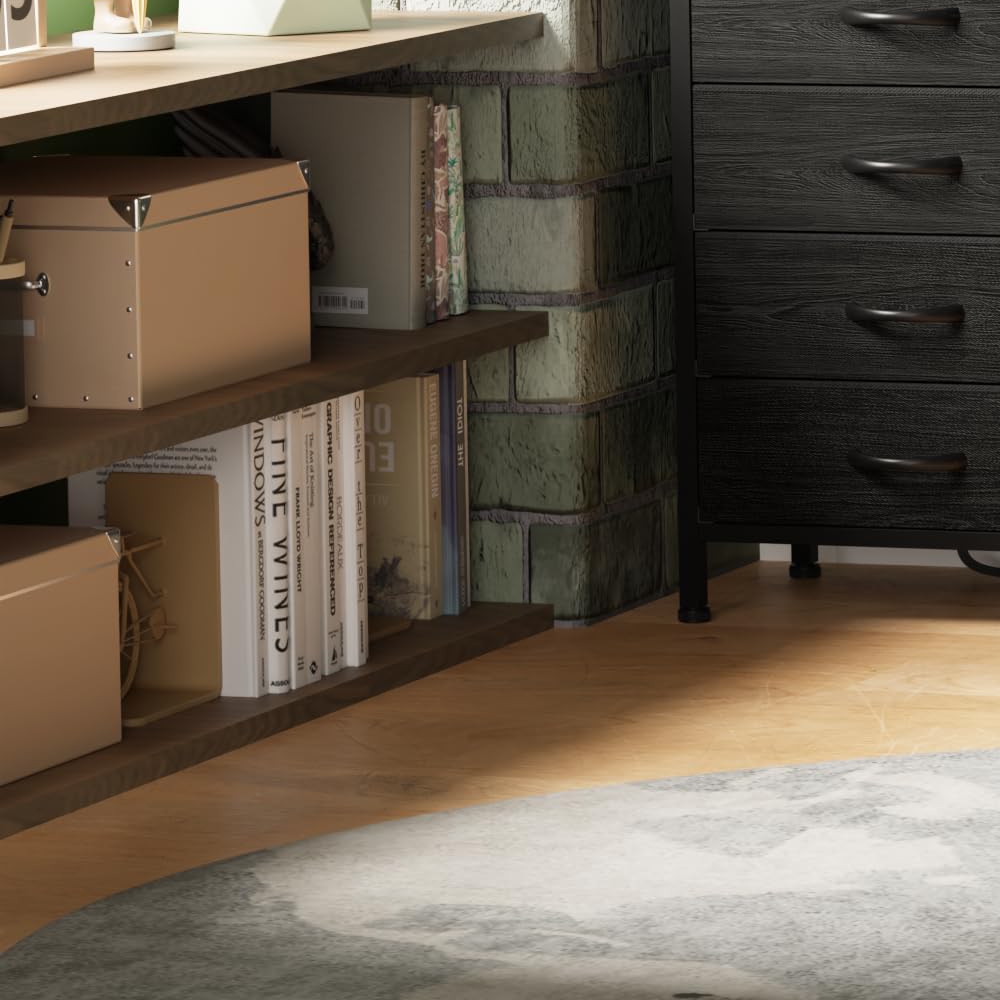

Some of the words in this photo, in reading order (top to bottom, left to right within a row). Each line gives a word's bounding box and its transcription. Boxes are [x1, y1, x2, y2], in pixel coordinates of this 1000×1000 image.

[326, 402, 334, 465] GRAPHIC
[428, 383, 438, 440] EUGENE
[271, 438, 288, 518] FINE
[327, 468, 335, 521] DESIGN
[430, 443, 439, 498] ONEGIN
[257, 539, 265, 588] BERGDORF
[328, 524, 336, 616] REFERENCED
[258, 589, 266, 641] GOODMAN
[271, 537, 289, 653] WINES
